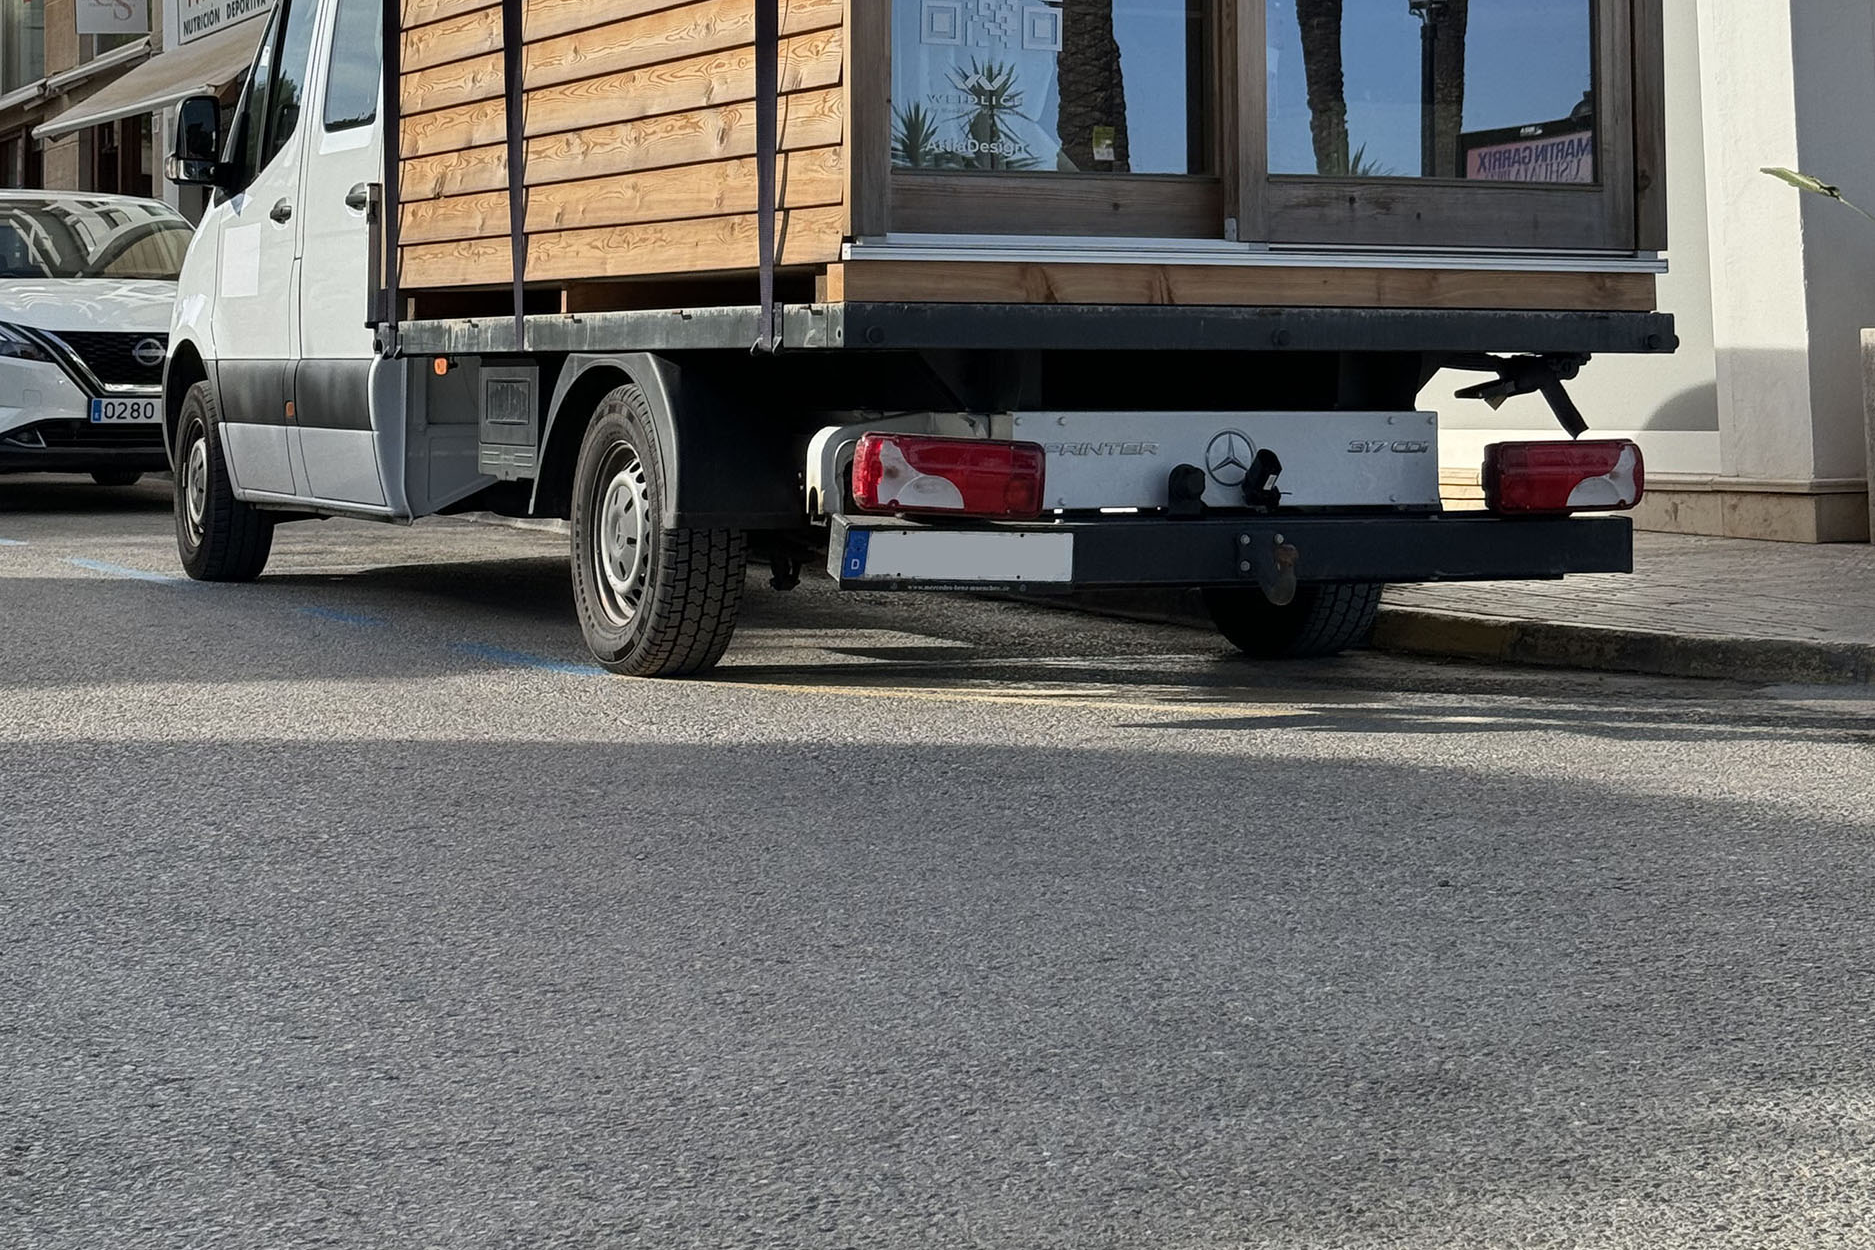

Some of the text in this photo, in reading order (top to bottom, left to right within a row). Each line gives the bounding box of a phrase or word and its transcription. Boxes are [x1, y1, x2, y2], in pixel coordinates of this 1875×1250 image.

[183, 4, 221, 37] NUTRICIÓN
[104, 401, 155, 420] 0280
[1043, 441, 1160, 456] PRINTER
[850, 558, 860, 570] D
